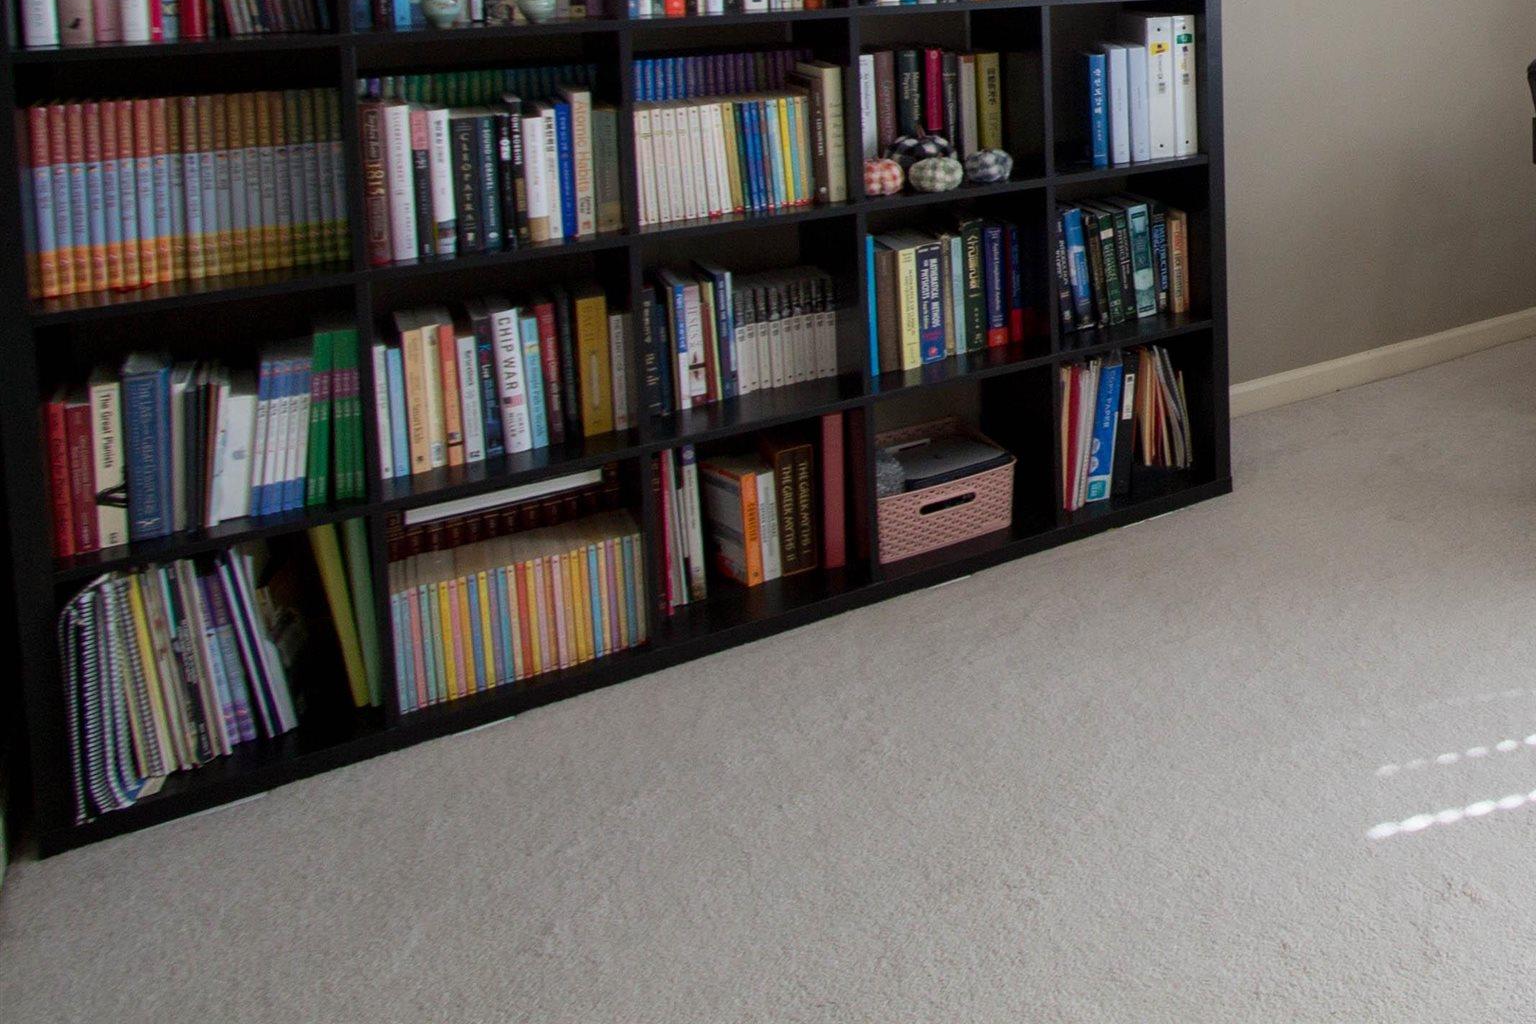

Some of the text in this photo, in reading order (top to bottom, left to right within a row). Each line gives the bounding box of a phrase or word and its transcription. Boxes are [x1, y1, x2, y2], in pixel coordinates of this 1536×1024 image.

[482, 128, 492, 155] SOUND
[574, 100, 592, 192] Atomic Habits
[485, 162, 495, 191] GRAVEL
[920, 269, 930, 300] PHYSICISTS
[929, 258, 941, 327] MATHEMATICAL METHODS
[497, 317, 519, 391] CHIP WAR
[101, 394, 115, 468] The Great Pianists
[782, 465, 793, 484] THE
[797, 461, 809, 481] THE
[782, 486, 793, 515] GREEK
[798, 482, 810, 511] GREEK
[783, 516, 794, 550] MYTHS
[799, 512, 811, 546] MYTHS
